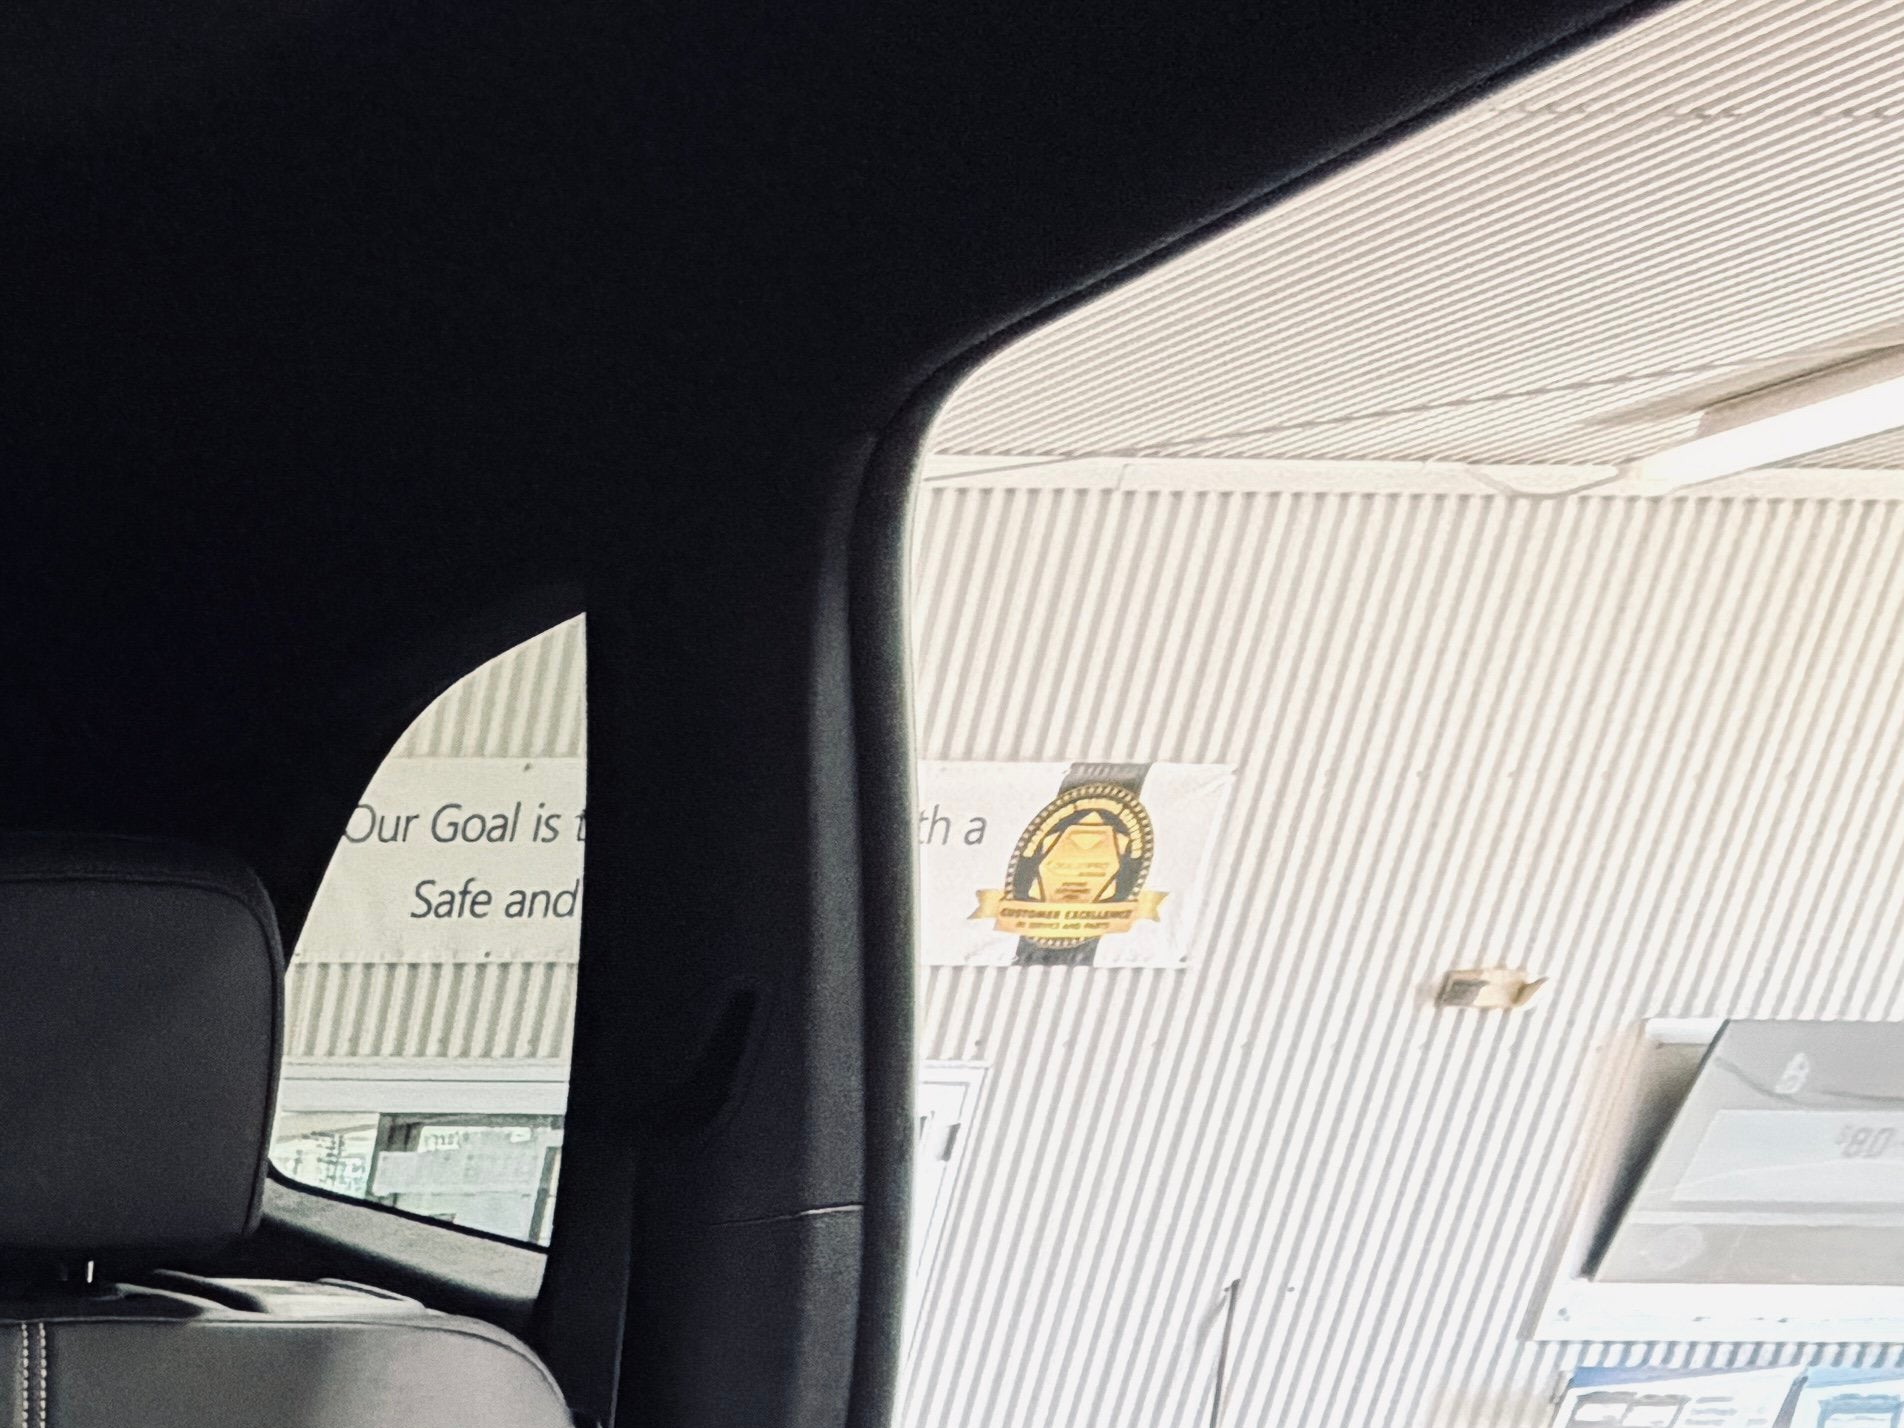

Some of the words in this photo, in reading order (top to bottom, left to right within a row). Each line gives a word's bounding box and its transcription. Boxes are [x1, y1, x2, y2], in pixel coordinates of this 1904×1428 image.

[345, 803, 420, 843] Our
[431, 801, 522, 843] Goal
[532, 802, 562, 843] is
[963, 816, 988, 846] a
[409, 876, 493, 919] Safe
[503, 878, 581, 919] and
[1000, 907, 1060, 920] CUSTOMER
[1064, 909, 1133, 920] EXCELLENCE
